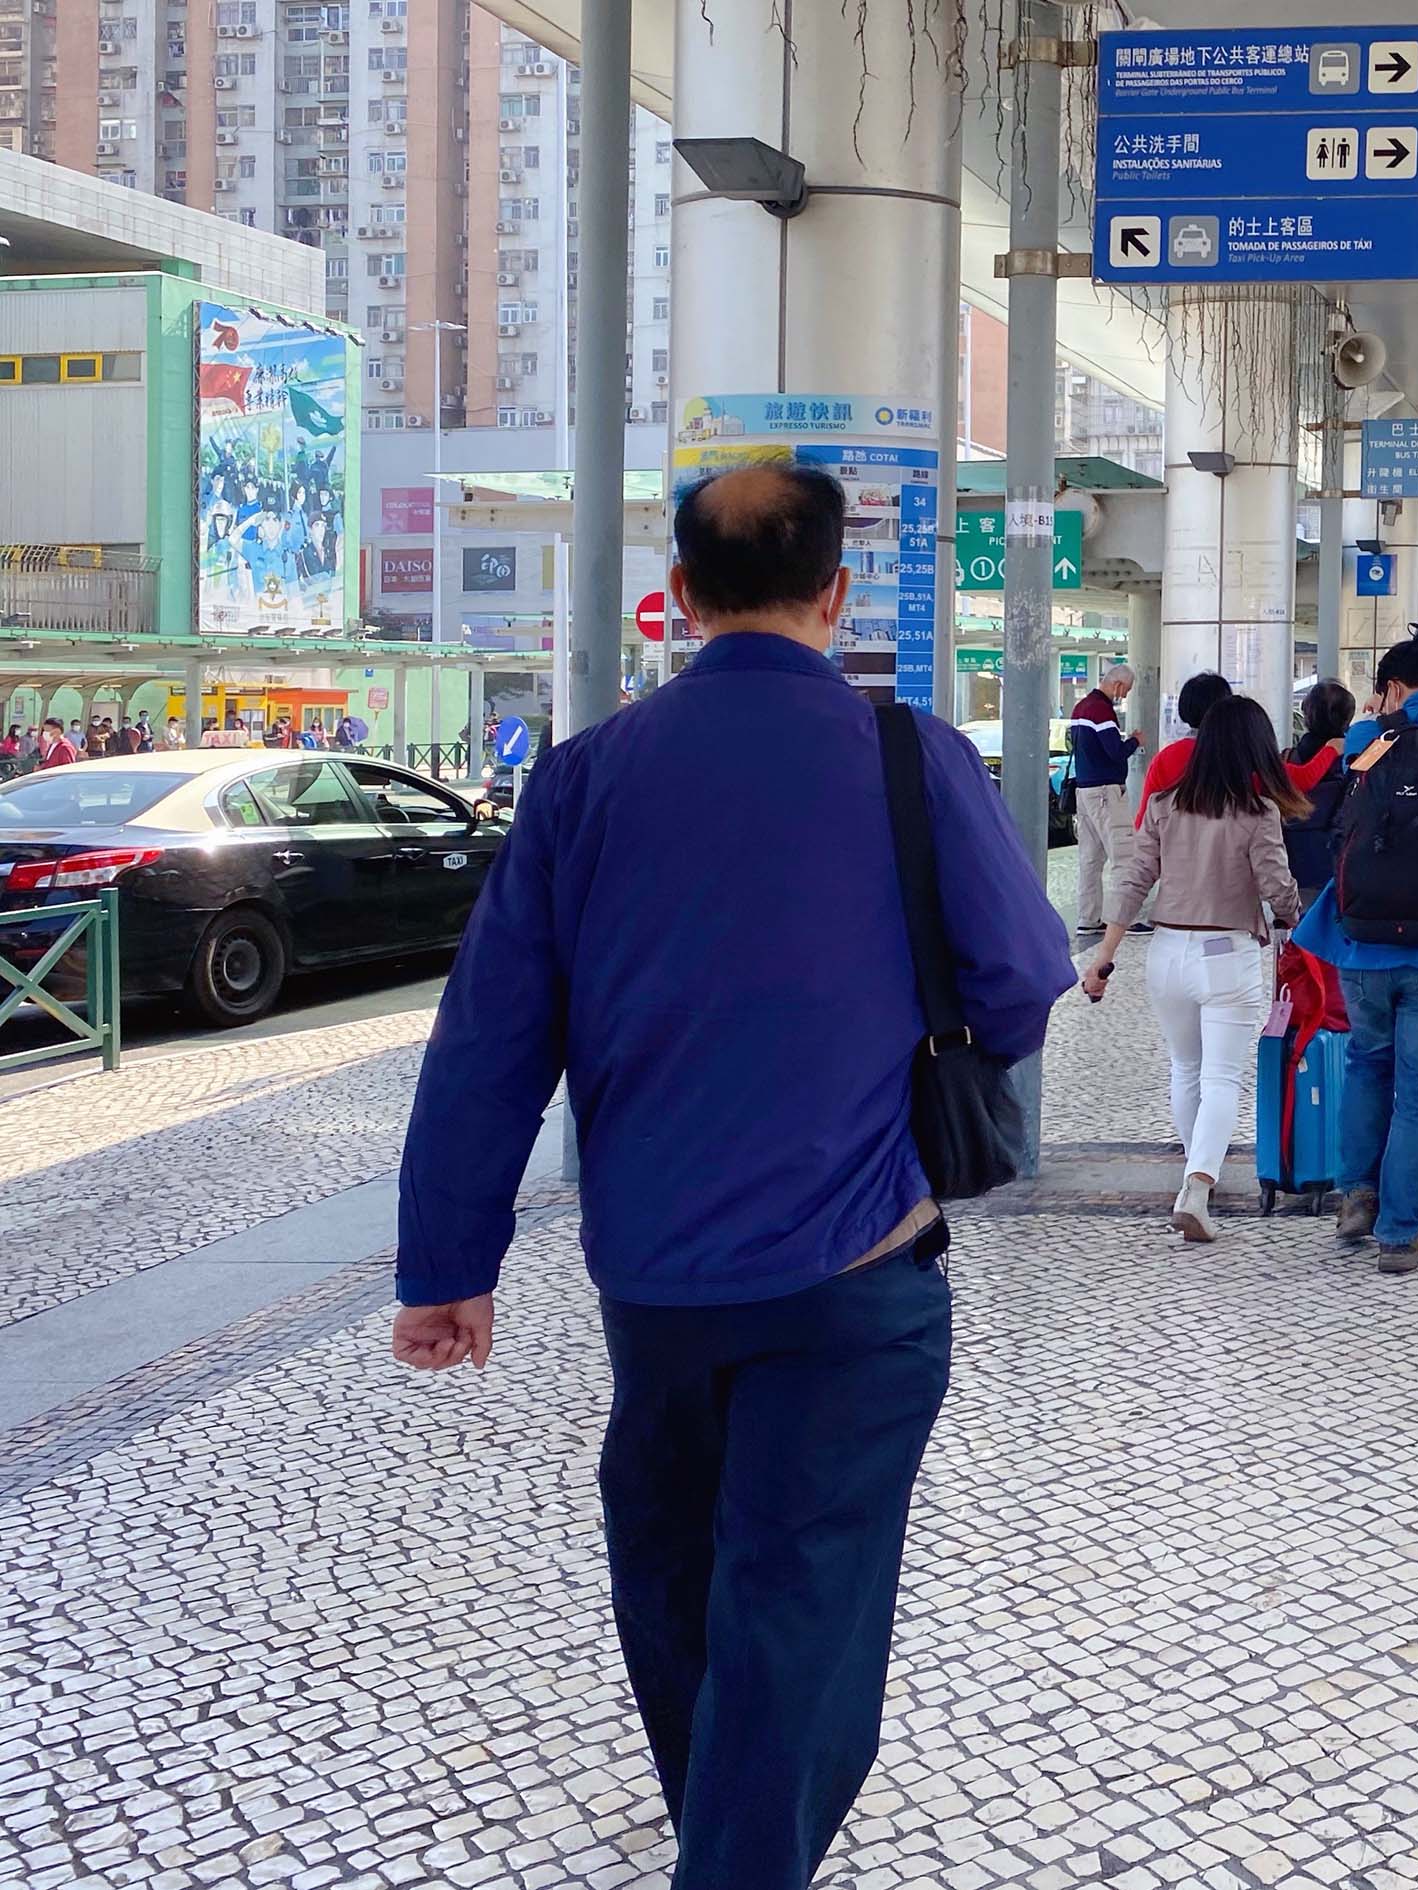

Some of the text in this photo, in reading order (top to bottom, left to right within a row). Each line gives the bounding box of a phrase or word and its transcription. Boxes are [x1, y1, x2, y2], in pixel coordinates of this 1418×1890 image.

[1115, 45, 1309, 67] 關閘廣場地下公共客運總站
[1116, 71, 1148, 79] TERMINAL
[1150, 69, 1196, 78] SUBTERRÂNEO
[1208, 68, 1253, 76] TRANSPORTES
[1254, 67, 1286, 76] PÚBLICOS
[1116, 80, 1124, 88] DE
[1125, 79, 1169, 87] PASSAGEIROS
[1184, 78, 1209, 86] PORTAS
[1221, 77, 1243, 85] CERCO
[1209, 86, 1231, 95] Public
[1247, 85, 1278, 94] Terminal
[1114, 133, 1200, 154] 公共洗手間
[1113, 157, 1222, 170] INSTALAÇÕES SANITÁRIAS
[1112, 171, 1170, 180] Public Toilets
[1229, 216, 1313, 237] 的士上客區
[1228, 238, 1372, 251] TOMADA DE PASSAGEIROS DE TÁXI
[1228, 253, 1304, 264] Taxi Pick-Up Area
[765, 402, 853, 421] 旅遊快訊
[769, 422, 846, 430] EXPRESSO TURISMO
[1370, 440, 1408, 448] TERMINAL
[869, 453, 898, 462] COTAI
[1395, 451, 1410, 459] BUS
[913, 496, 926, 507] 34
[909, 537, 928, 548] 51A
[384, 560, 431, 573] DAISO
[900, 563, 934, 575] 25,25B
[908, 604, 926, 612] MT4
[898, 631, 934, 641] 25,51A
[204, 732, 238, 747] TAXI
[447, 855, 464, 867] TAXI
